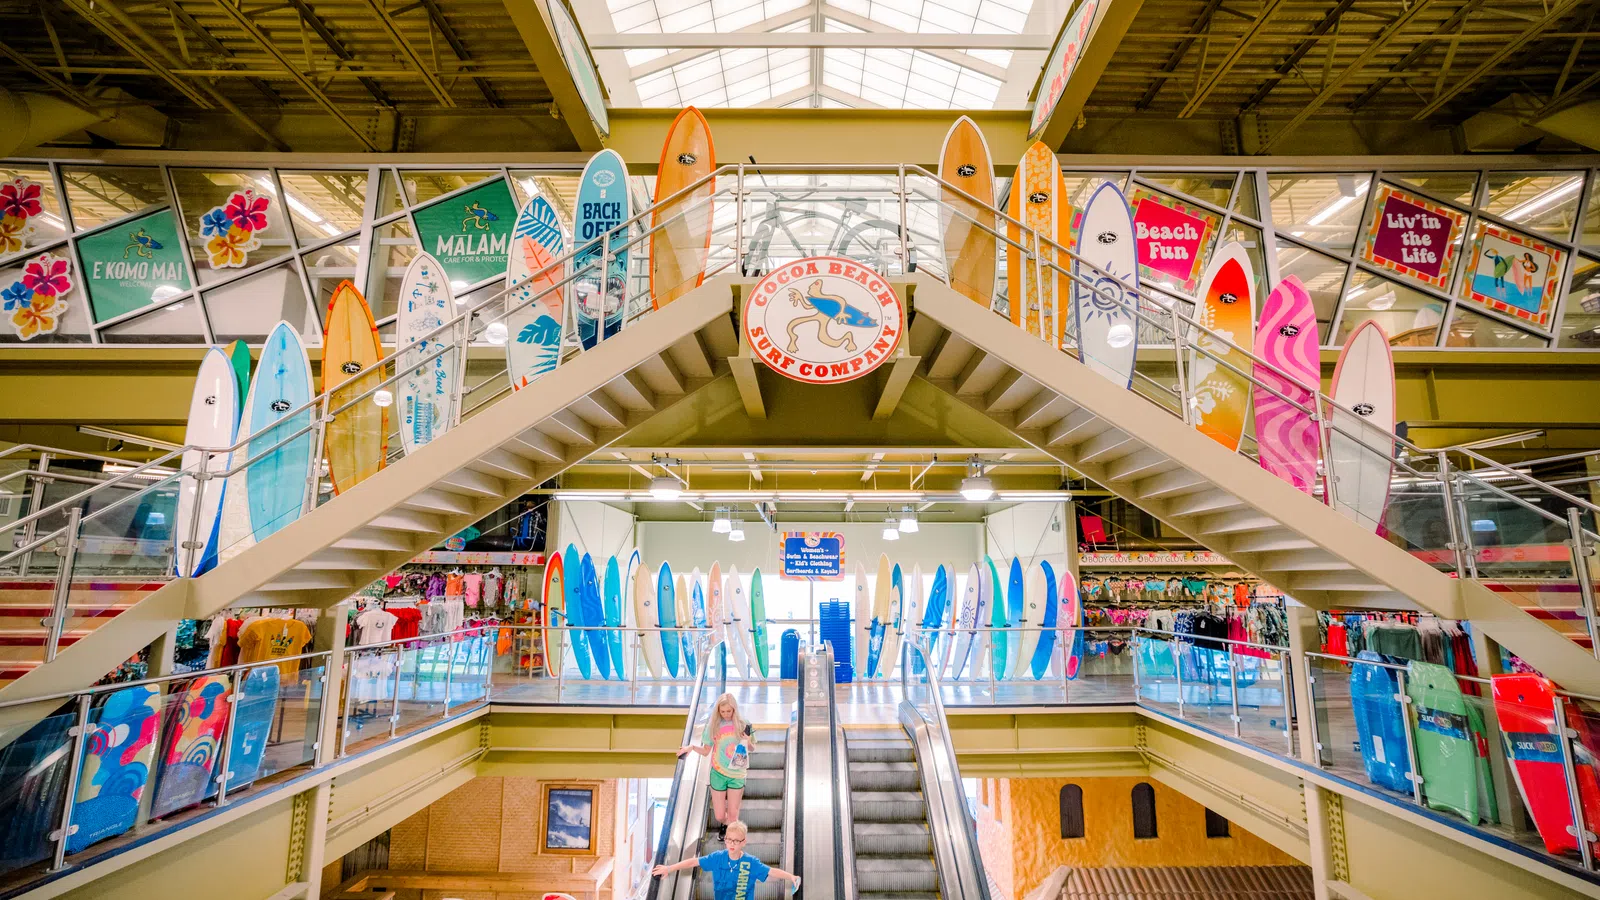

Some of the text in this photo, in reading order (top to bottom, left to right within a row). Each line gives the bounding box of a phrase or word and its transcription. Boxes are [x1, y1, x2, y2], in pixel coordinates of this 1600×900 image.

[583, 202, 621, 219] BACK
[1386, 213, 1441, 229] Liv'in
[1135, 222, 1199, 240] Beach
[1401, 231, 1432, 246] the
[436, 232, 509, 256] MĀLAM
[1149, 241, 1189, 260] Fun
[1401, 247, 1437, 264] Life
[93, 261, 183, 280] E KOMO MAI
[754, 261, 894, 307] COCOA BEACH
[750, 324, 896, 378] SURF COMPANY
[810, 560, 833, 568] Clothing
[1088, 554, 1132, 563] BODY GLOVE
[1144, 554, 1187, 563] BODY GLOVE
[1200, 555, 1220, 563] BODY
[1516, 741, 1536, 750] SLICK
[89, 822, 123, 839] TRIANGLE
